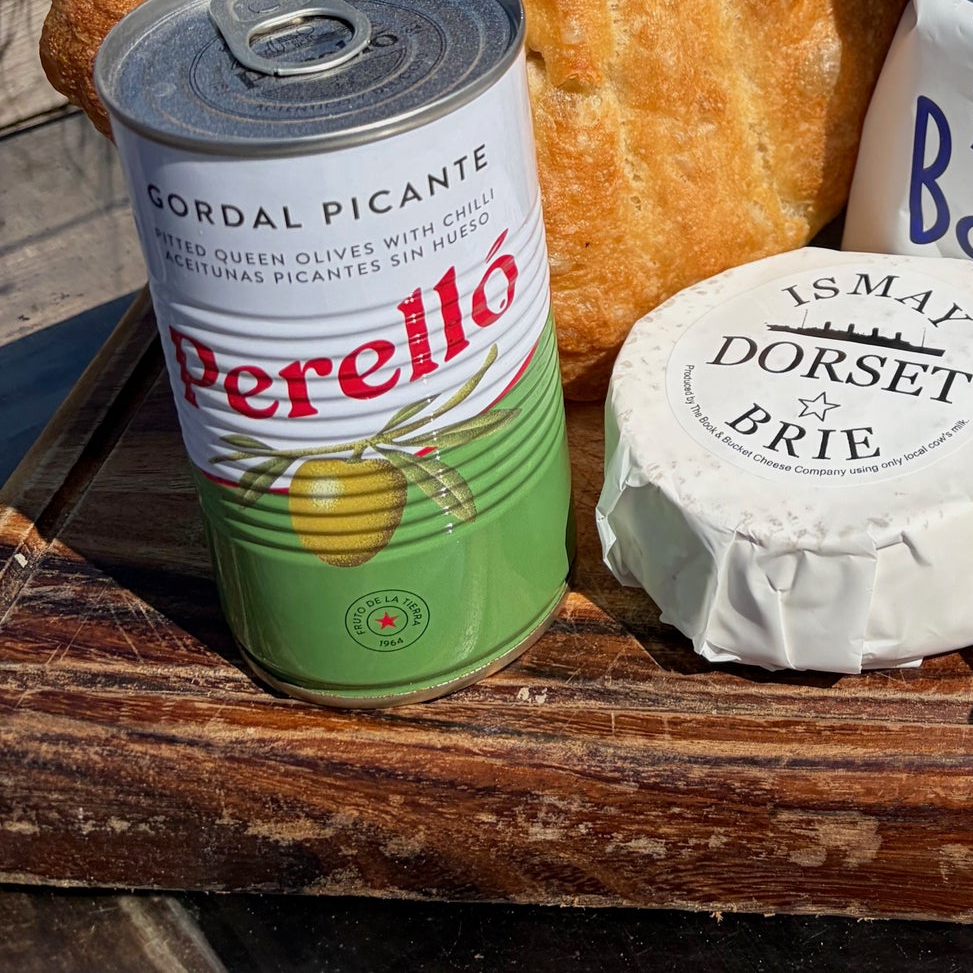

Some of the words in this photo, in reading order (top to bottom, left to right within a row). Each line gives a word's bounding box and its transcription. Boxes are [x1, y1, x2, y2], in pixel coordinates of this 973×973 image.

[147, 183, 303, 230] GORDAL
[322, 143, 488, 226] PICANTE
[155, 227, 206, 257] PITTED
[214, 249, 285, 266] QUEEN
[295, 242, 375, 265] OLIVES
[384, 222, 435, 249] WITH
[442, 188, 495, 228] CHILLI
[165, 251, 265, 284] ACEITUNAS
[274, 261, 382, 284] PICANTES
[391, 246, 424, 267] SIN
[433, 211, 490, 253] HUESO
[781, 273, 973, 328] ISMAY
[169, 228, 519, 420] Perelló
[705, 335, 973, 405] DORSET
[683, 364, 695, 396] Produced
[685, 396, 695, 405] by
[690, 404, 702, 419] The
[699, 416, 718, 435] Book
[725, 402, 881, 461] BRIE
[951, 418, 970, 434] milk.
[715, 431, 724, 439] &
[928, 433, 953, 450] cow's
[721, 435, 753, 458] Bucket
[903, 446, 928, 461] local
[753, 453, 792, 471] Cheese
[794, 465, 847, 477] Company
[849, 464, 879, 475] using
[881, 457, 903, 468] only
[353, 607, 366, 635] FRUTO
[365, 597, 381, 608] DE
[402, 597, 422, 627] TIERRA
[379, 637, 404, 647] 1964
